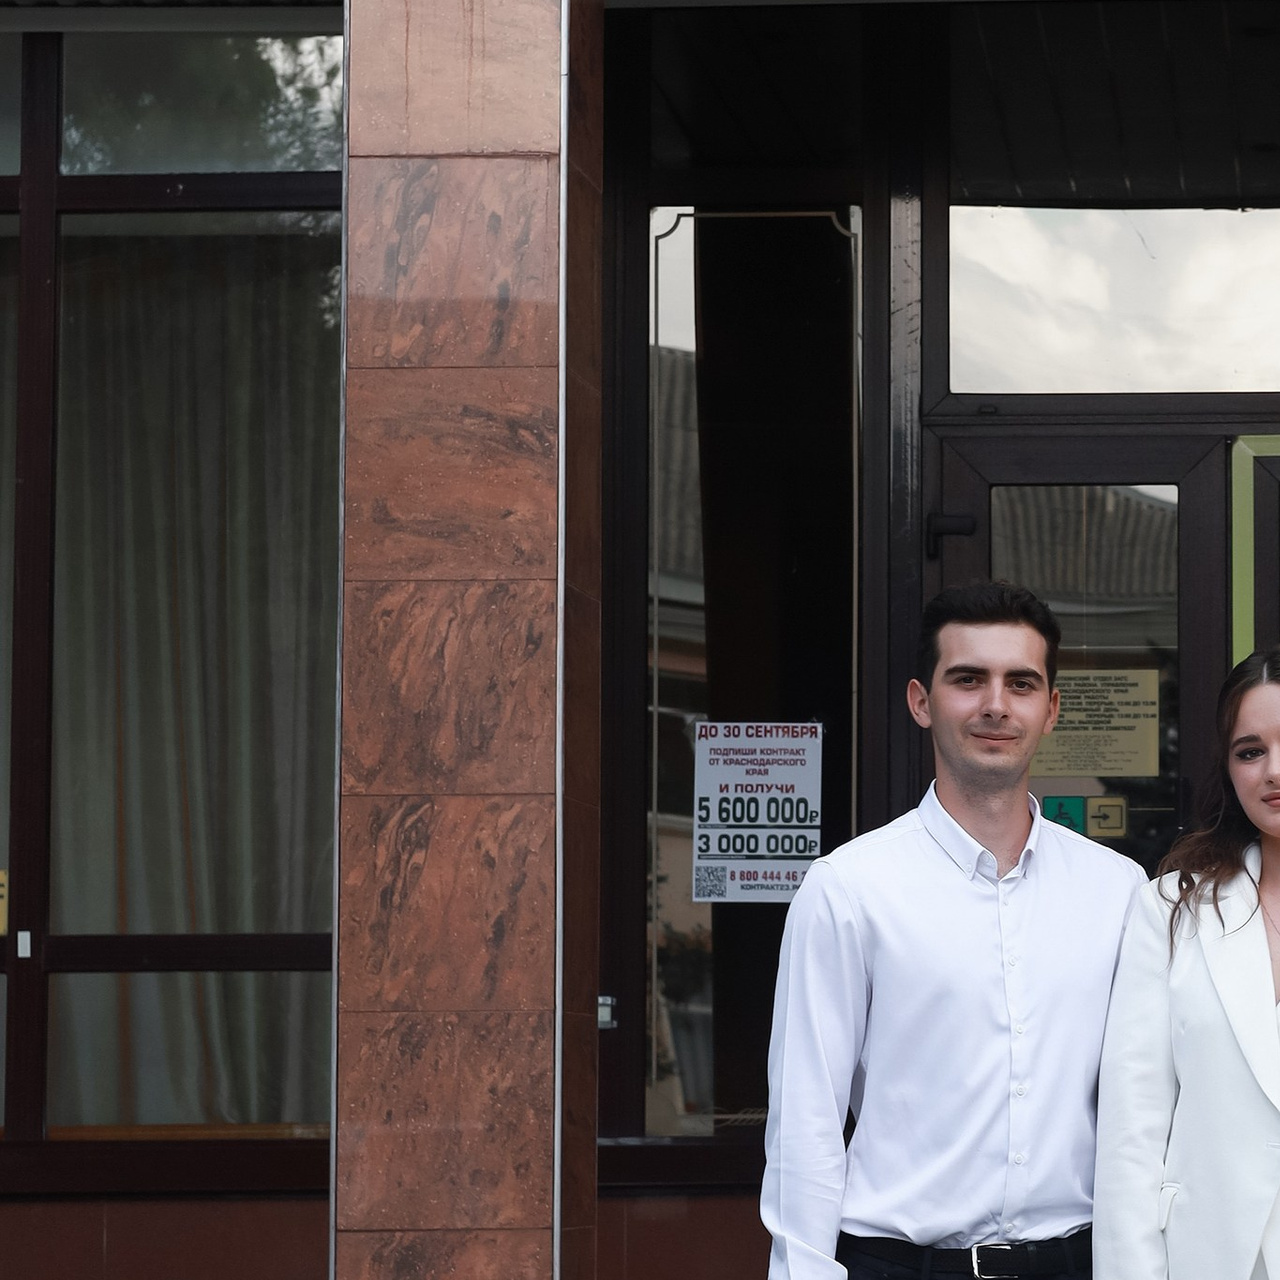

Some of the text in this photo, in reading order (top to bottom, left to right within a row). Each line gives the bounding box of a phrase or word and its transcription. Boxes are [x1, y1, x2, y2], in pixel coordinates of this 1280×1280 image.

[698, 725, 818, 740] ДО 30 СЕНТЯБРЯ
[709, 748, 806, 757] ПОДПИШИ КОНТРАКТ
[709, 758, 806, 767] ОТ КРАСНОДАРСКОГО
[745, 768, 769, 776] КРАЯ
[719, 784, 795, 794] И ПОЛУЧИ
[698, 796, 710, 823] 5
[718, 796, 759, 823] 600
[698, 834, 710, 853] 3
[718, 834, 759, 853] 000
[729, 870, 736, 881] 8
[739, 870, 759, 881] 800
[762, 870, 781, 881] 444
[784, 870, 798, 881] 46
